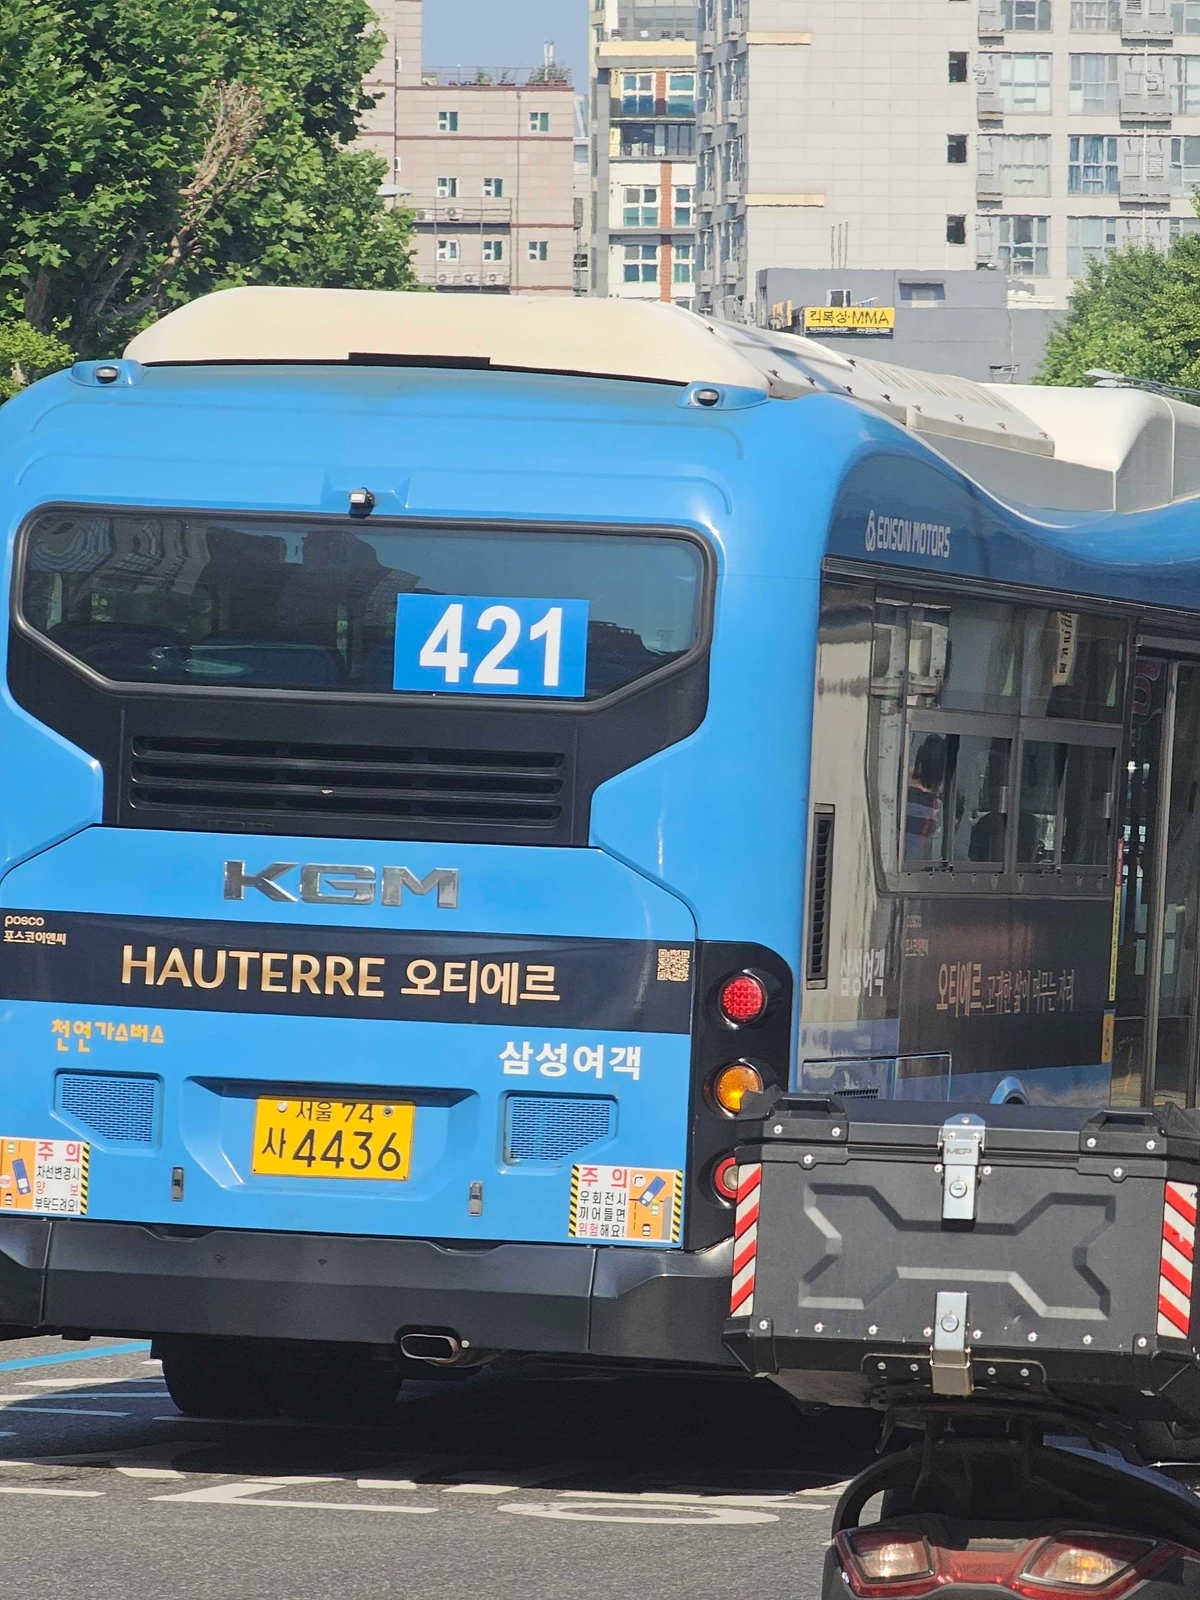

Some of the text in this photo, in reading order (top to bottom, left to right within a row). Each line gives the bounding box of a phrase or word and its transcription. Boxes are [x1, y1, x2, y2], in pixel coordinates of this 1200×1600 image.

[877, 516, 951, 558] EDISON MOTORS
[419, 603, 563, 687] 421
[223, 859, 460, 910] KGM
[3, 929, 67, 946] 포스코이앤씨
[5, 915, 45, 928] posco
[121, 944, 561, 1007] HAUTERRE 오티에르
[51, 1018, 165, 1053] 천연가스버스
[498, 1041, 643, 1081] 삼성여객
[296, 1100, 375, 1124] 서울 74
[36, 1164, 80, 1181] 차선변경시
